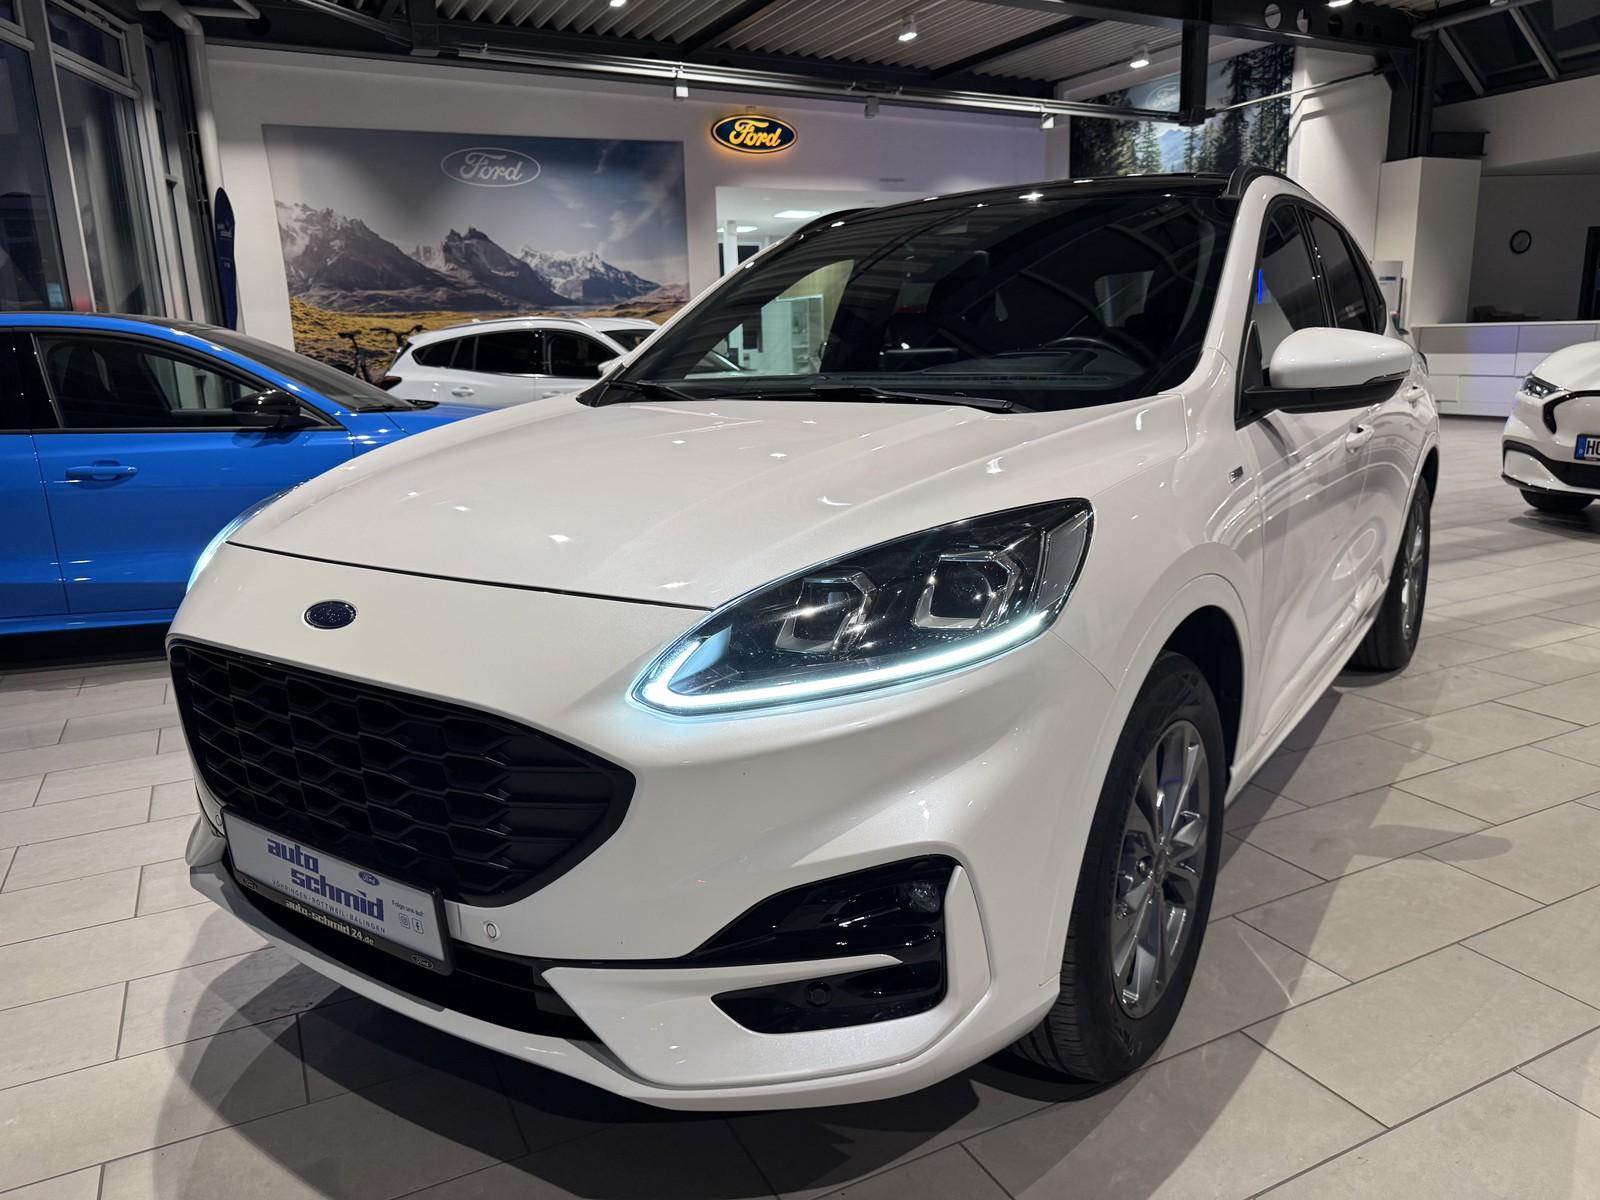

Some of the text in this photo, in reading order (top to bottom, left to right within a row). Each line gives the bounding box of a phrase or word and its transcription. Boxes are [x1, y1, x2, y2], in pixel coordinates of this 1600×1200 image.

[728, 119, 783, 148] Ford
[459, 151, 523, 182] Ford
[267, 838, 320, 874] auto
[291, 867, 385, 922] schmid
